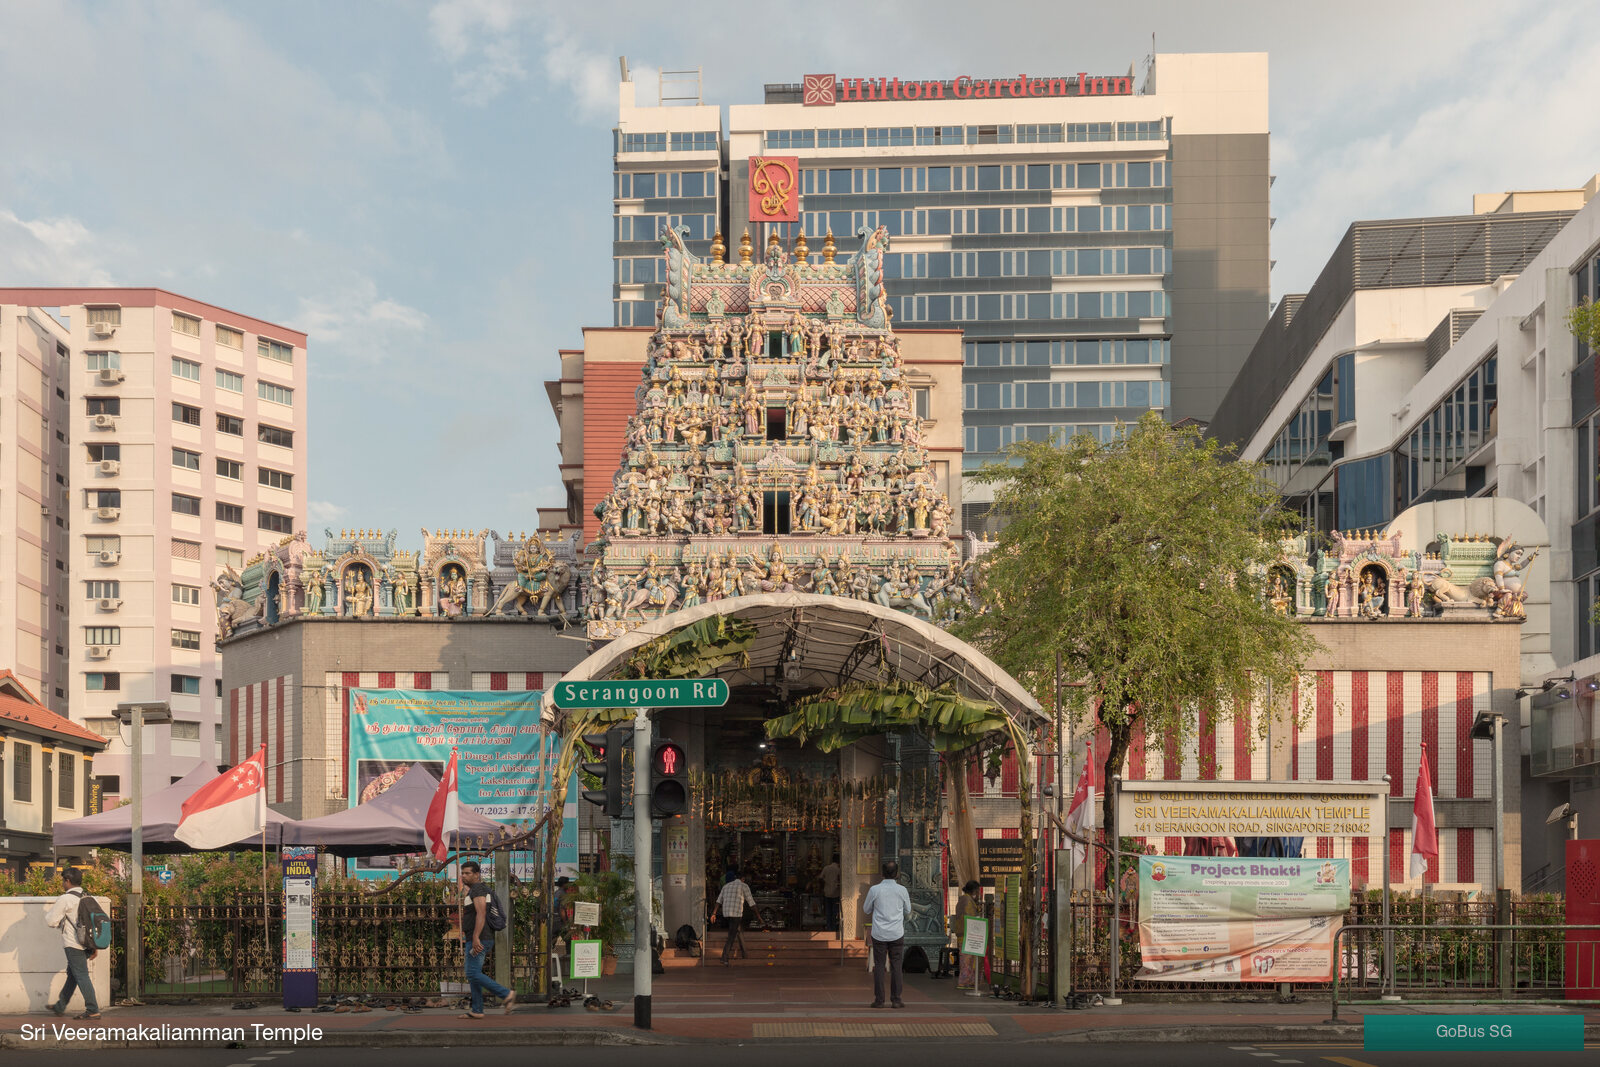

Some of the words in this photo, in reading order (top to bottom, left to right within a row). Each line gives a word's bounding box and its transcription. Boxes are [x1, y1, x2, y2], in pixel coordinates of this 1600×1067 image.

[841, 77, 946, 100] Hilton
[952, 74, 1068, 99] Garden
[1077, 72, 1132, 96] Inn
[566, 684, 680, 704] Serangoon
[693, 682, 717, 698] Rd
[464, 752, 494, 761] Durga
[496, 752, 535, 760] Lakshmi
[465, 764, 498, 775] Special
[479, 788, 492, 797] for
[494, 788, 516, 797] Aadi
[1134, 806, 1158, 818] SRI
[1161, 806, 1312, 818] VEERAMAKALIAMMAN
[1315, 807, 1370, 818] TEMPLE
[1134, 822, 1152, 832] 141
[1155, 822, 1226, 832] SERANGOON
[1229, 822, 1263, 834] ROAD,
[1266, 823, 1331, 832] SINGAPORE
[1333, 823, 1370, 832] 218042
[286, 866, 312, 875] INDIA
[1190, 864, 1247, 878] Project
[1250, 865, 1300, 876] Bhakti
